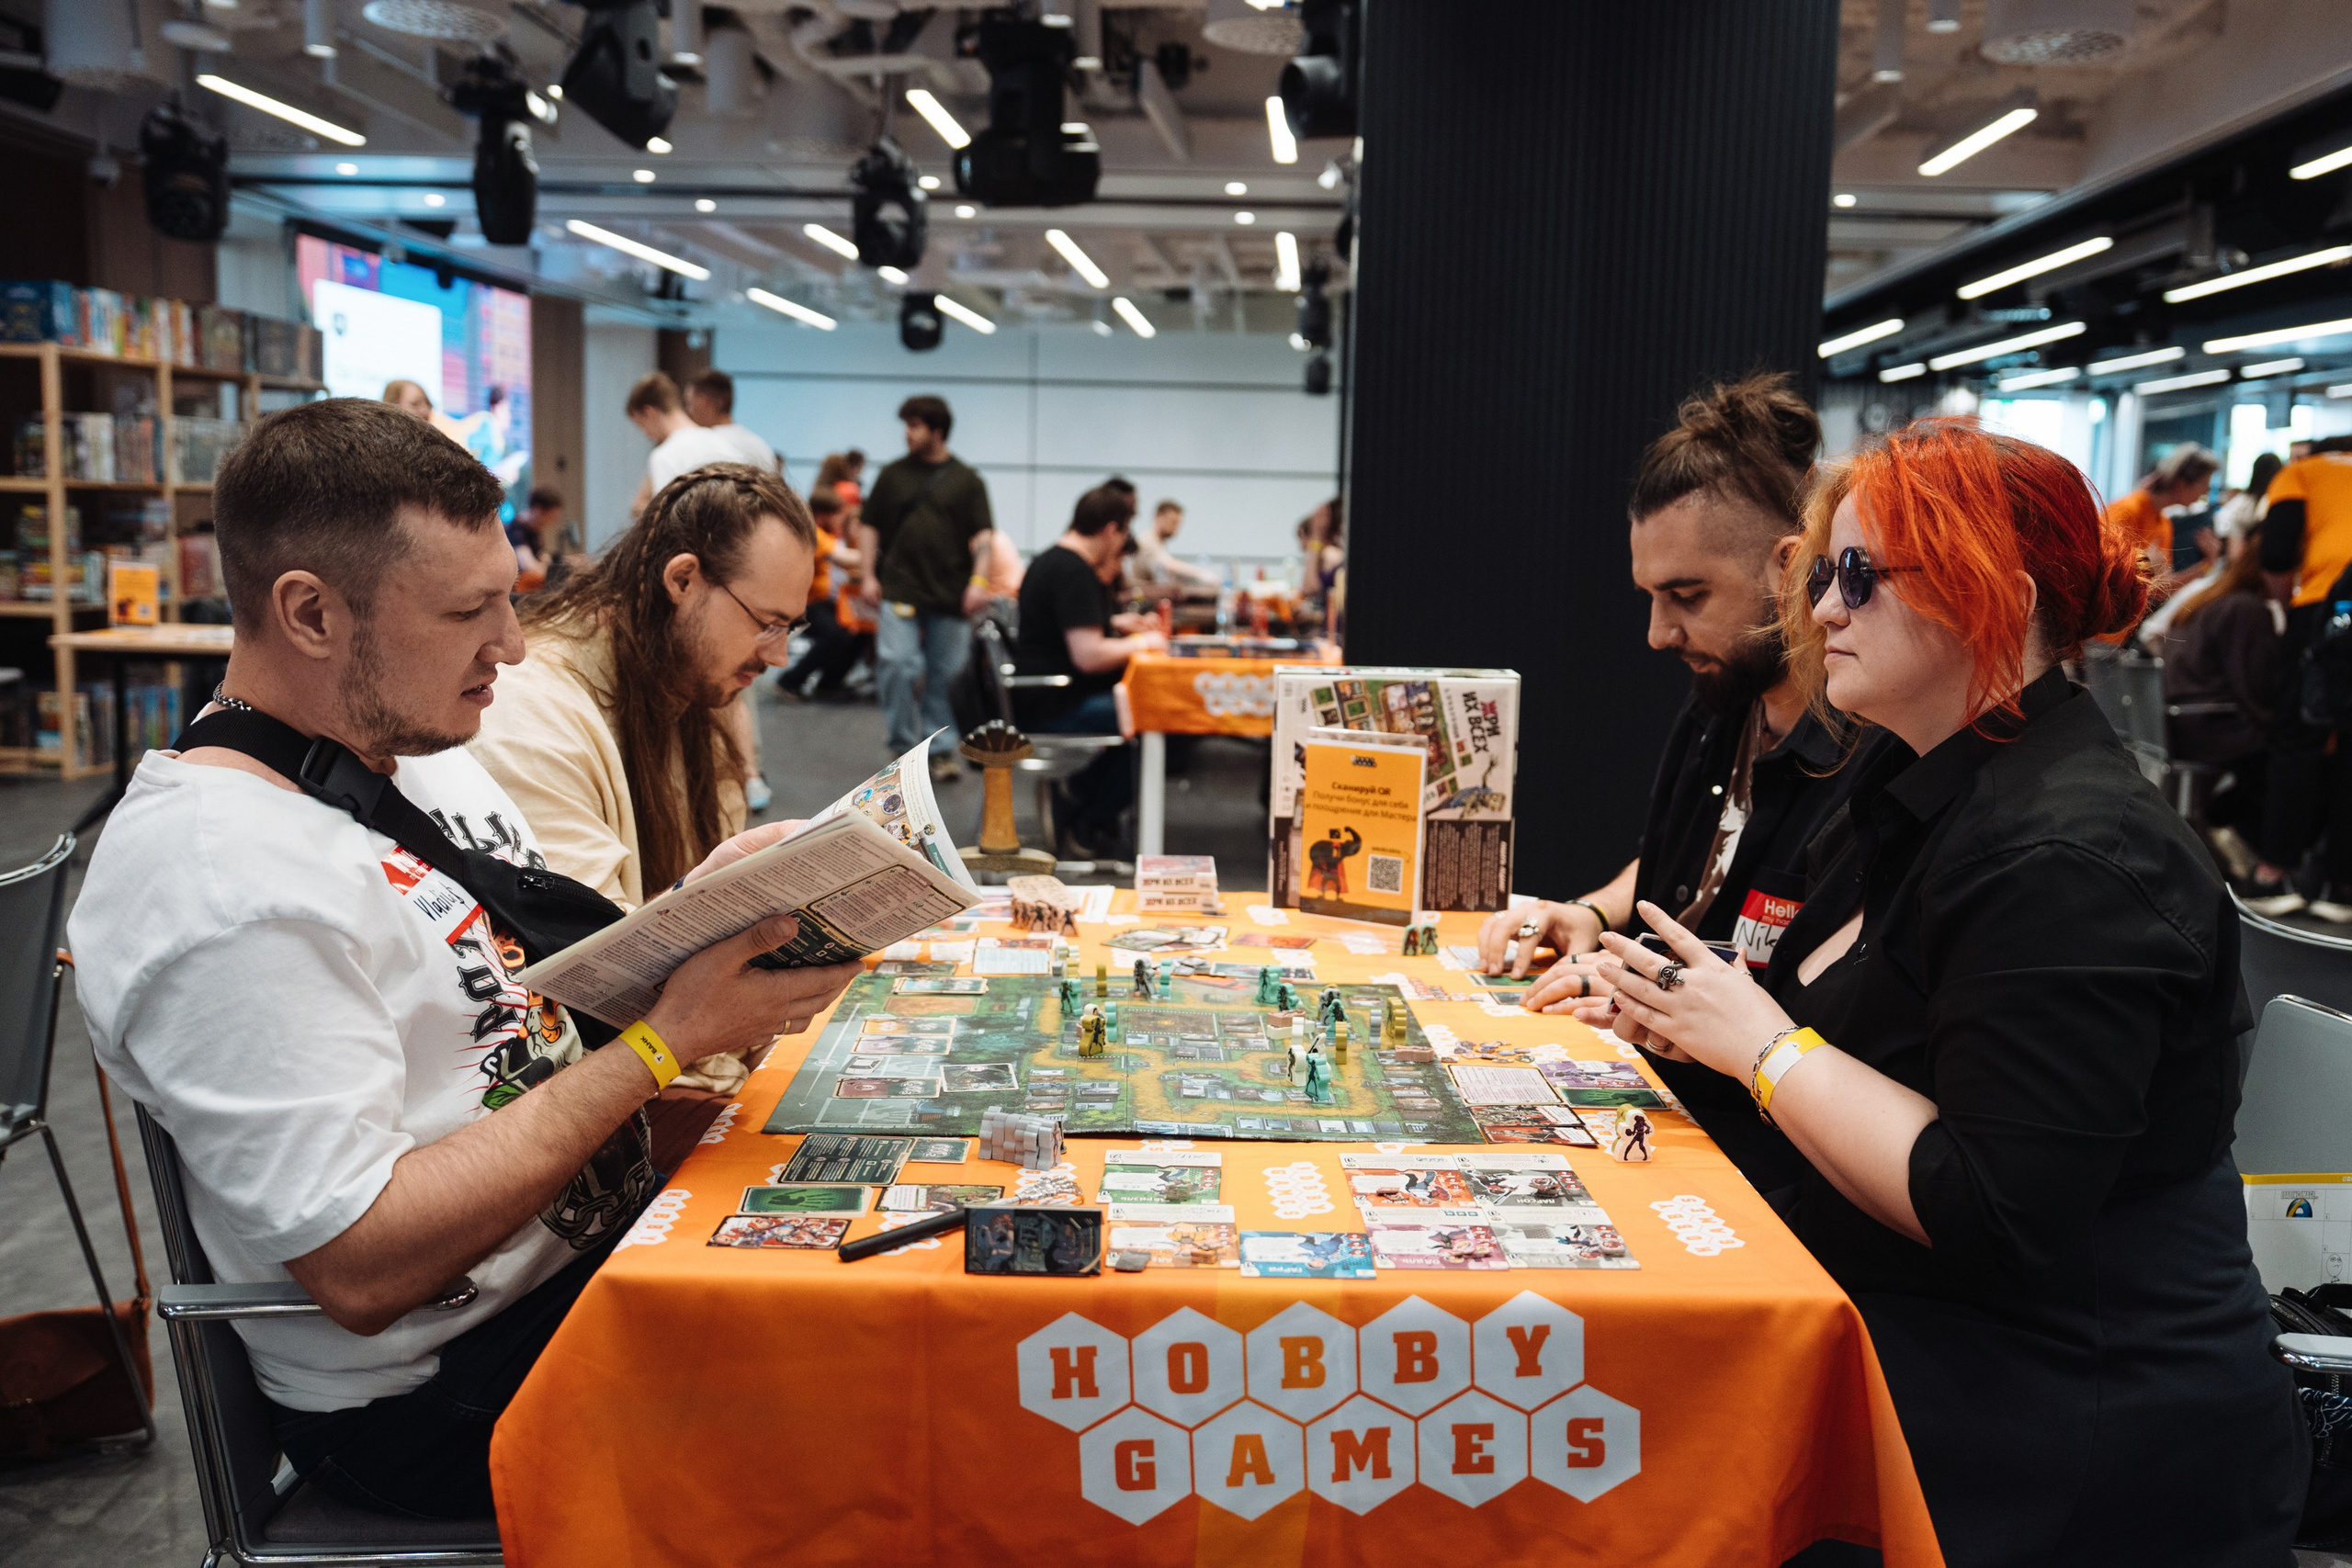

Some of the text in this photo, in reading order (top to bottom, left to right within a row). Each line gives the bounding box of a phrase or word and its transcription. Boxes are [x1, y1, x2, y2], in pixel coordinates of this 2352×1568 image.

[1468, 716, 1490, 753] ВСЕХ
[1331, 782, 1391, 796] Сканируй QR
[1346, 794, 1372, 806] бонус
[1764, 899, 1799, 919] Hell
[640, 1036, 657, 1055] БАНК
[1049, 1324, 1551, 1399] HOBBY
[1114, 1417, 1606, 1492] GAMES
